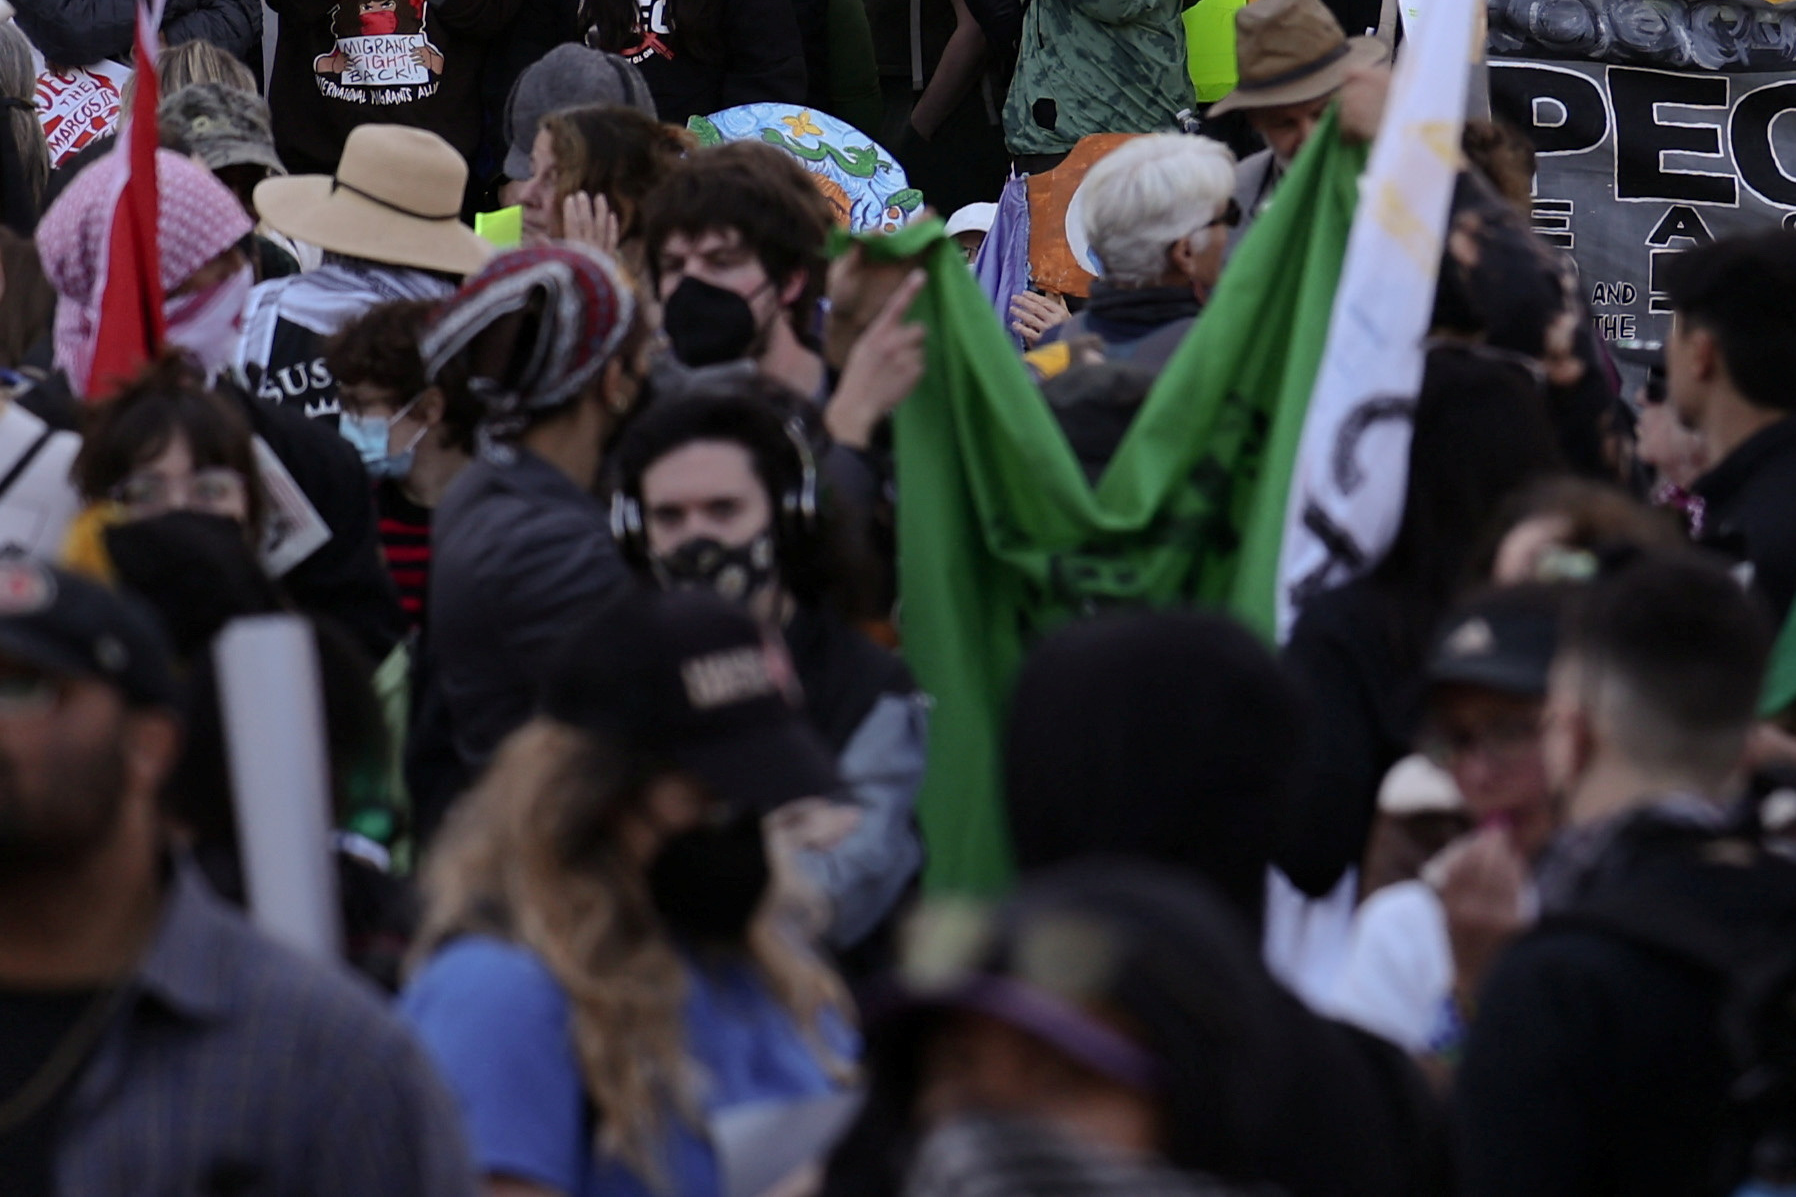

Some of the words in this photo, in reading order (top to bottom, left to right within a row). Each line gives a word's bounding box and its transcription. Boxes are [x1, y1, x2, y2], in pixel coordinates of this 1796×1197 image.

[343, 36, 417, 55] MIGRANTS
[350, 54, 409, 70] FIGHT
[59, 81, 92, 107] THE
[48, 96, 102, 155] MARCOS
[1592, 281, 1637, 306] AND
[1592, 314, 1637, 342] THE
